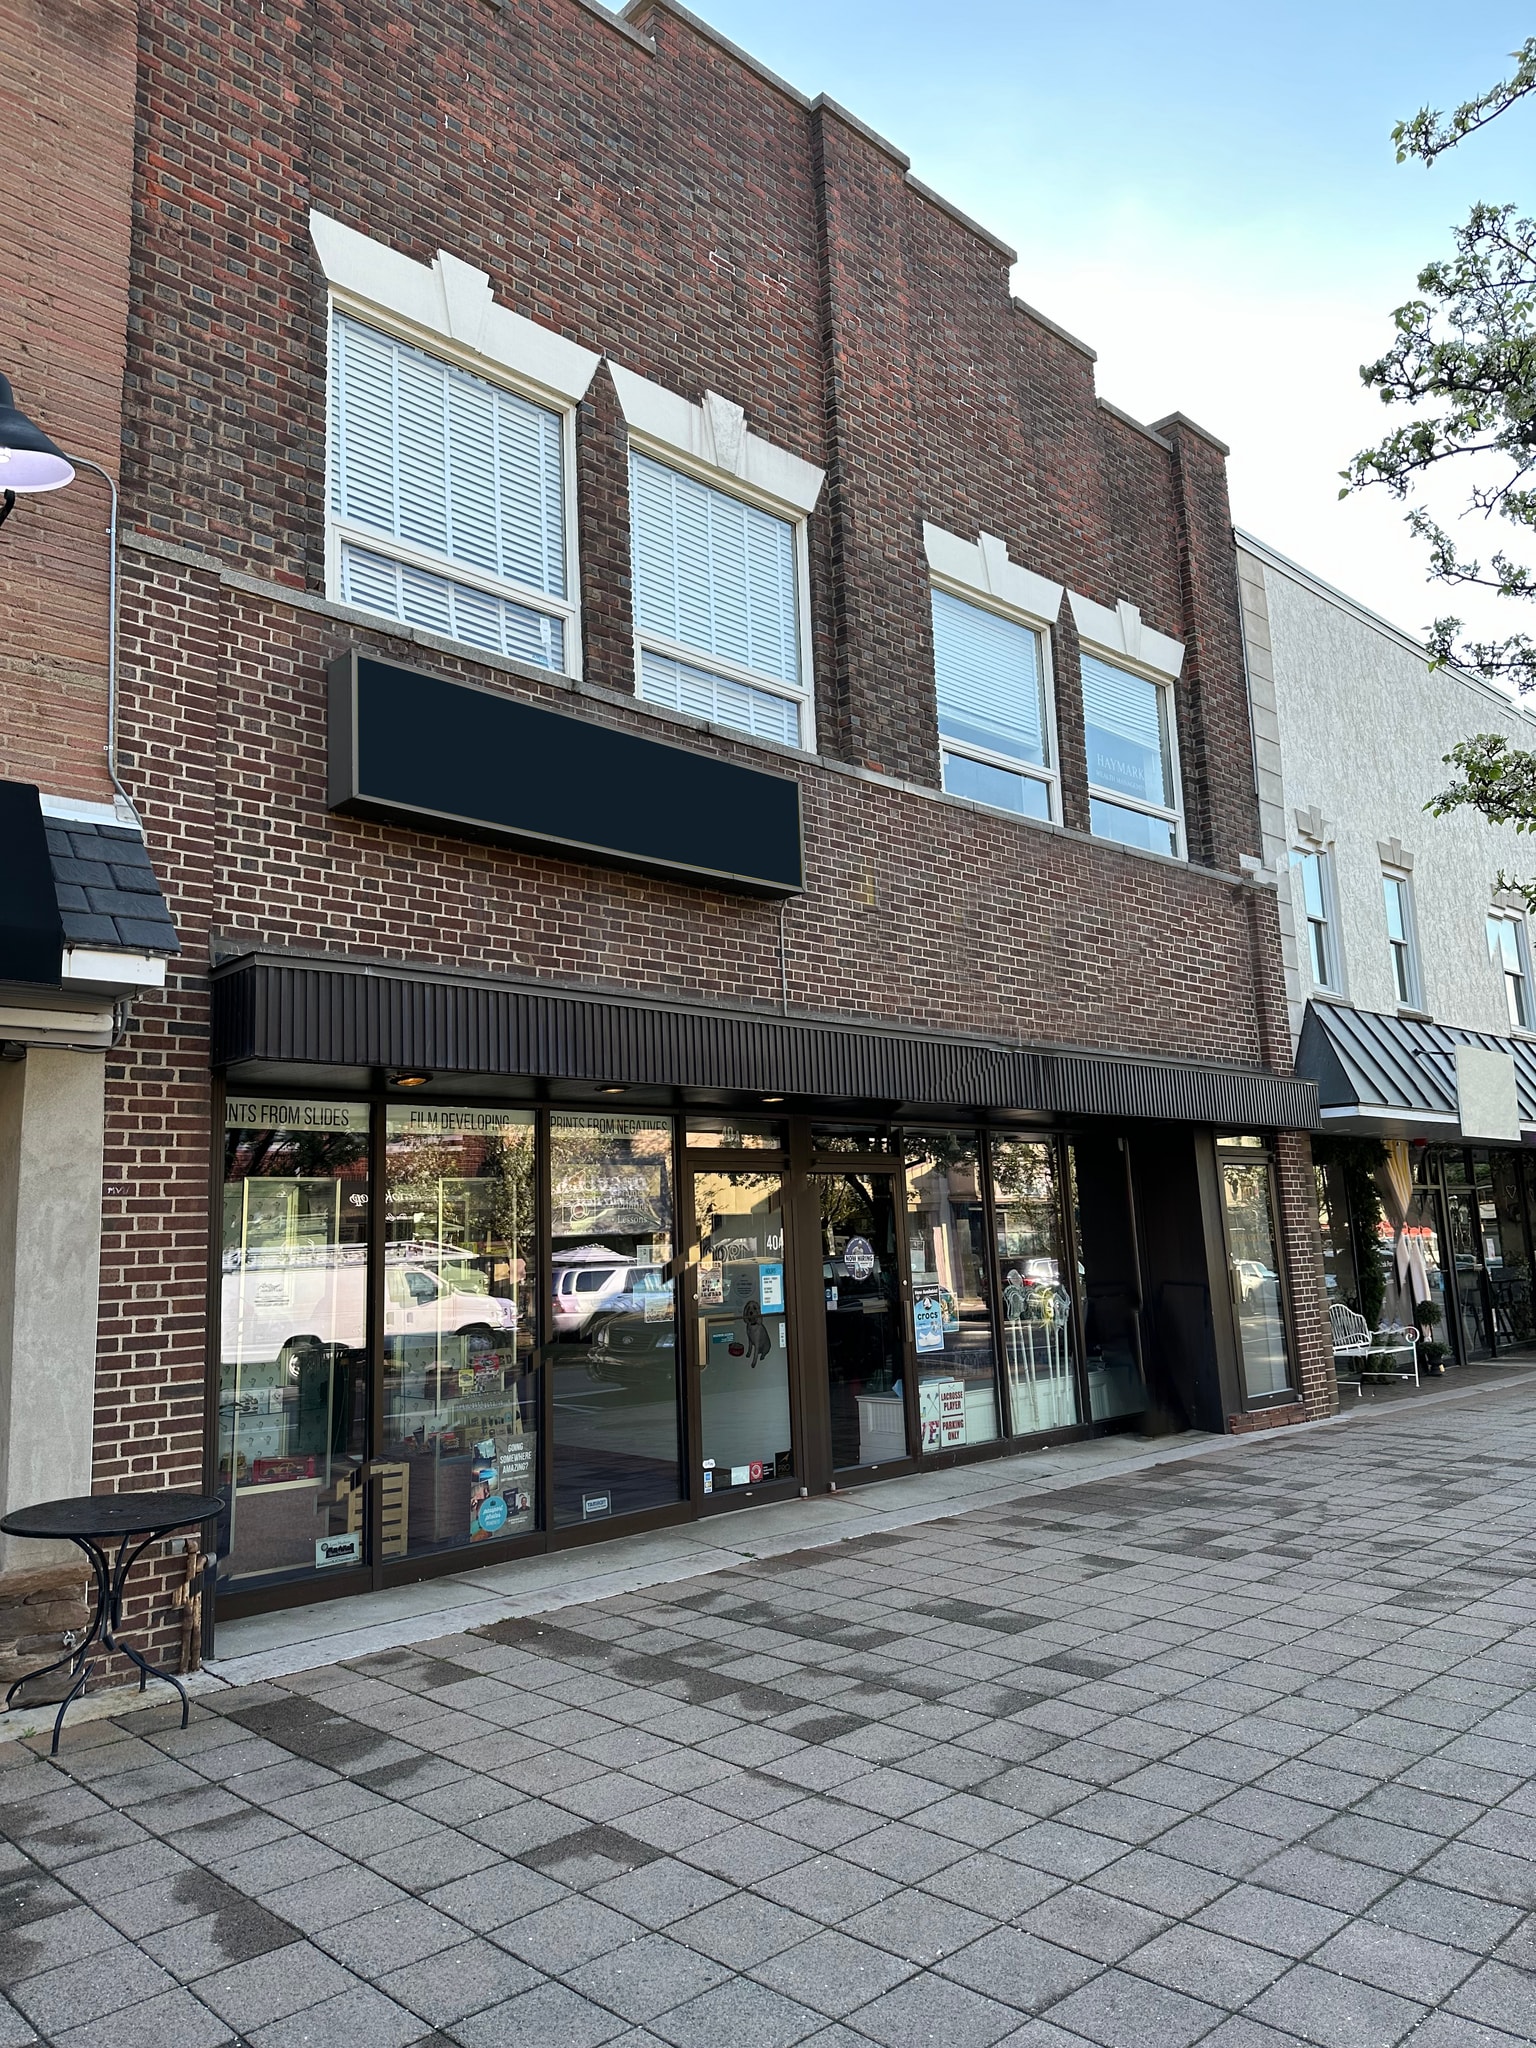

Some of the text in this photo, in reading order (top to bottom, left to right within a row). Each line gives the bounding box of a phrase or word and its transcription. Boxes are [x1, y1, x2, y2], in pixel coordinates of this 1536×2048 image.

[1096, 753, 1146, 781] HAYMARK
[261, 1105, 300, 1125] FROM
[304, 1107, 349, 1127] SLIDES
[410, 1111, 510, 1131] FILM DEVELOPING
[550, 1116, 668, 1135] PRINTS FROM NEGATIVES
[617, 1214, 648, 1224] Lessons
[766, 1234, 784, 1251] 40A
[917, 1311, 938, 1320] crocs
[940, 1390, 964, 1401] LACROSSE
[943, 1400, 962, 1412] PLAYER
[942, 1419, 964, 1431] PARKING
[947, 1430, 960, 1441] ONLY
[507, 1442, 524, 1453] GOING
[499, 1451, 532, 1464] SOMEWHERE
[502, 1461, 530, 1475] AMAZING?
